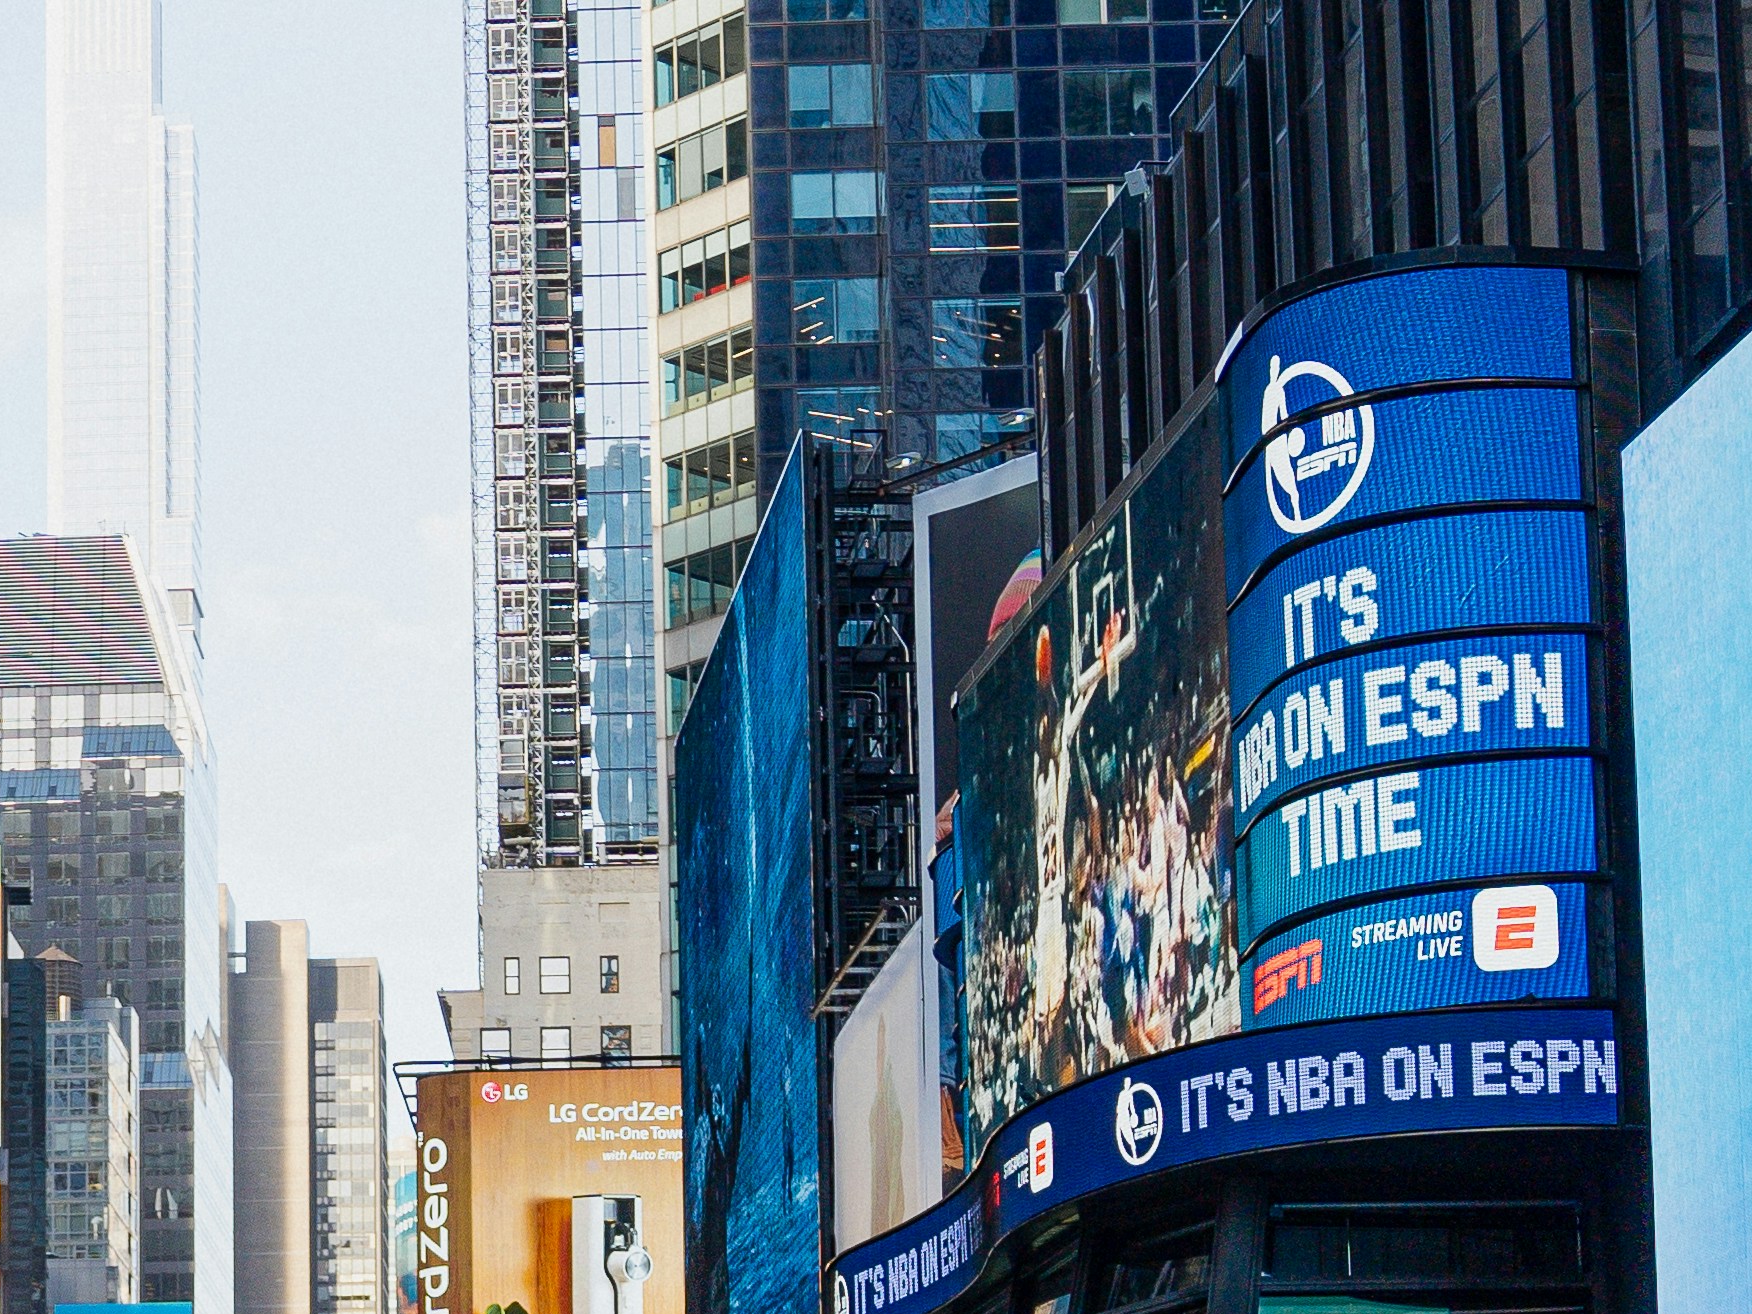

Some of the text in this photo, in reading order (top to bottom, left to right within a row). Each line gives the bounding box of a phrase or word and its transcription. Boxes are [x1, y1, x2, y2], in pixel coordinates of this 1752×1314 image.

[1322, 416, 1356, 444] NBA
[1297, 442, 1357, 480] ESPN
[1283, 566, 1379, 669] IT'S
[1239, 652, 1565, 813] NBA ON ESPN
[1281, 771, 1422, 878] TIME
[1351, 910, 1463, 948] STREAMING
[1417, 935, 1463, 961] LIVE
[1254, 938, 1323, 1015] ESPN
[503, 1083, 529, 1101] LG
[1181, 1039, 1618, 1132] IT'S NBA ON ESPN
[549, 1104, 577, 1123] LG
[575, 1126, 648, 1142] All-In-One
[603, 1149, 655, 1162] with Auto
[888, 1252, 918, 1306] NBA
[921, 1243, 939, 1290] ON
[941, 1223, 968, 1279] ESPN
